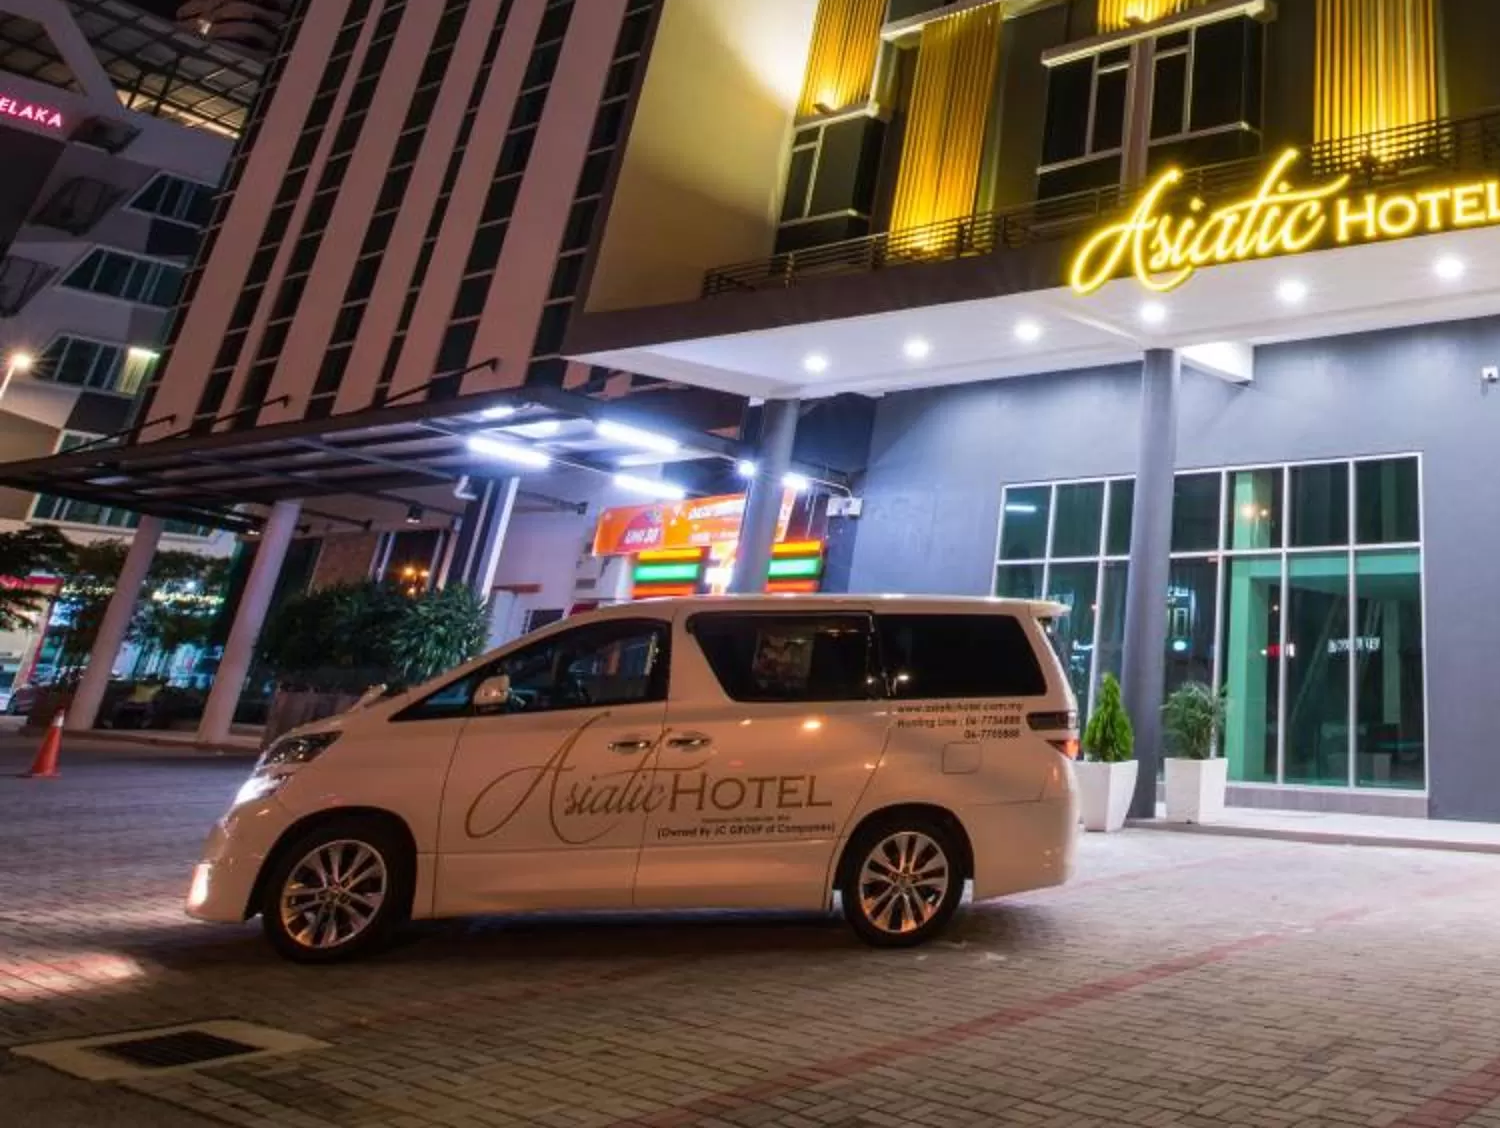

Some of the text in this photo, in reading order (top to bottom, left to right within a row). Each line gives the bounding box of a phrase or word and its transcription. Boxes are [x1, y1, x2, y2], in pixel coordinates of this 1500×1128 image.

[0, 97, 61, 127] ELAKA
[1069, 148, 1349, 294] Asiatic
[466, 711, 832, 843] Asiatic HOTEL
